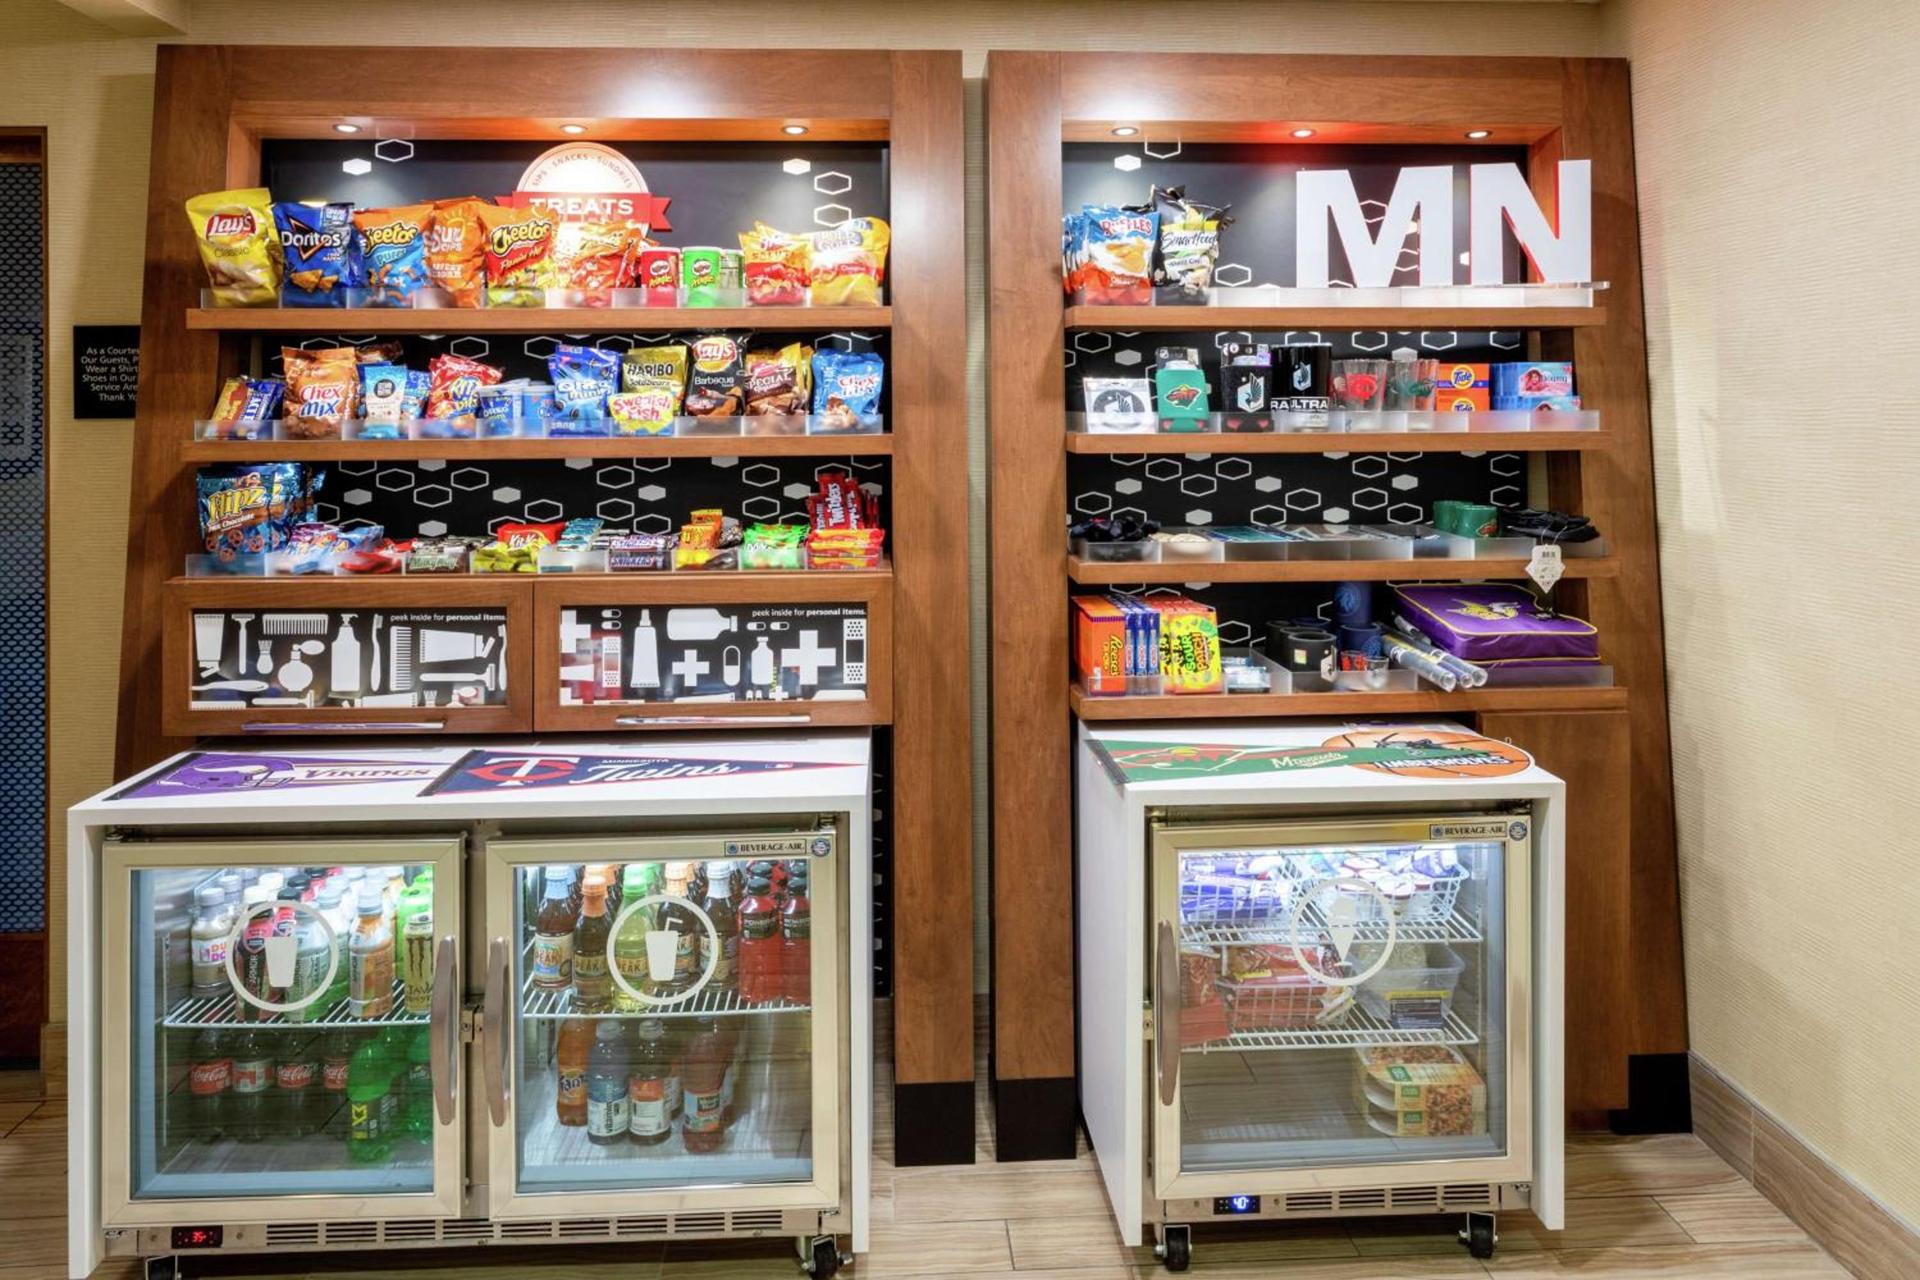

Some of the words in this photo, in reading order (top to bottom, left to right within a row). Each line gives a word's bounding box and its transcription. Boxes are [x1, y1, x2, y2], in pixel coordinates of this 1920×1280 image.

[528, 198, 634, 216] TREATS
[1296, 159, 1592, 288] MN
[281, 230, 342, 247] Doritos
[491, 220, 551, 256] Cheetos
[86, 347, 98, 355] As
[81, 356, 98, 364] Our
[85, 365, 108, 374] Wear
[627, 363, 674, 377] HARIBO
[82, 374, 107, 383] Shoes
[109, 373, 118, 381] in
[119, 374, 137, 382] Our
[1453, 370, 1472, 384] Tide
[90, 383, 121, 392] Service
[301, 384, 346, 401] Chex
[98, 393, 125, 401] Thank
[390, 614, 409, 622] peek
[410, 613, 432, 621] inside
[433, 613, 444, 621] for
[446, 613, 481, 622] personal
[751, 609, 770, 618] peek
[771, 609, 792, 617] inside
[794, 608, 805, 616] for
[806, 608, 841, 618] personal
[1180, 634, 1197, 672] SOUR
[1190, 631, 1209, 672] PATCH
